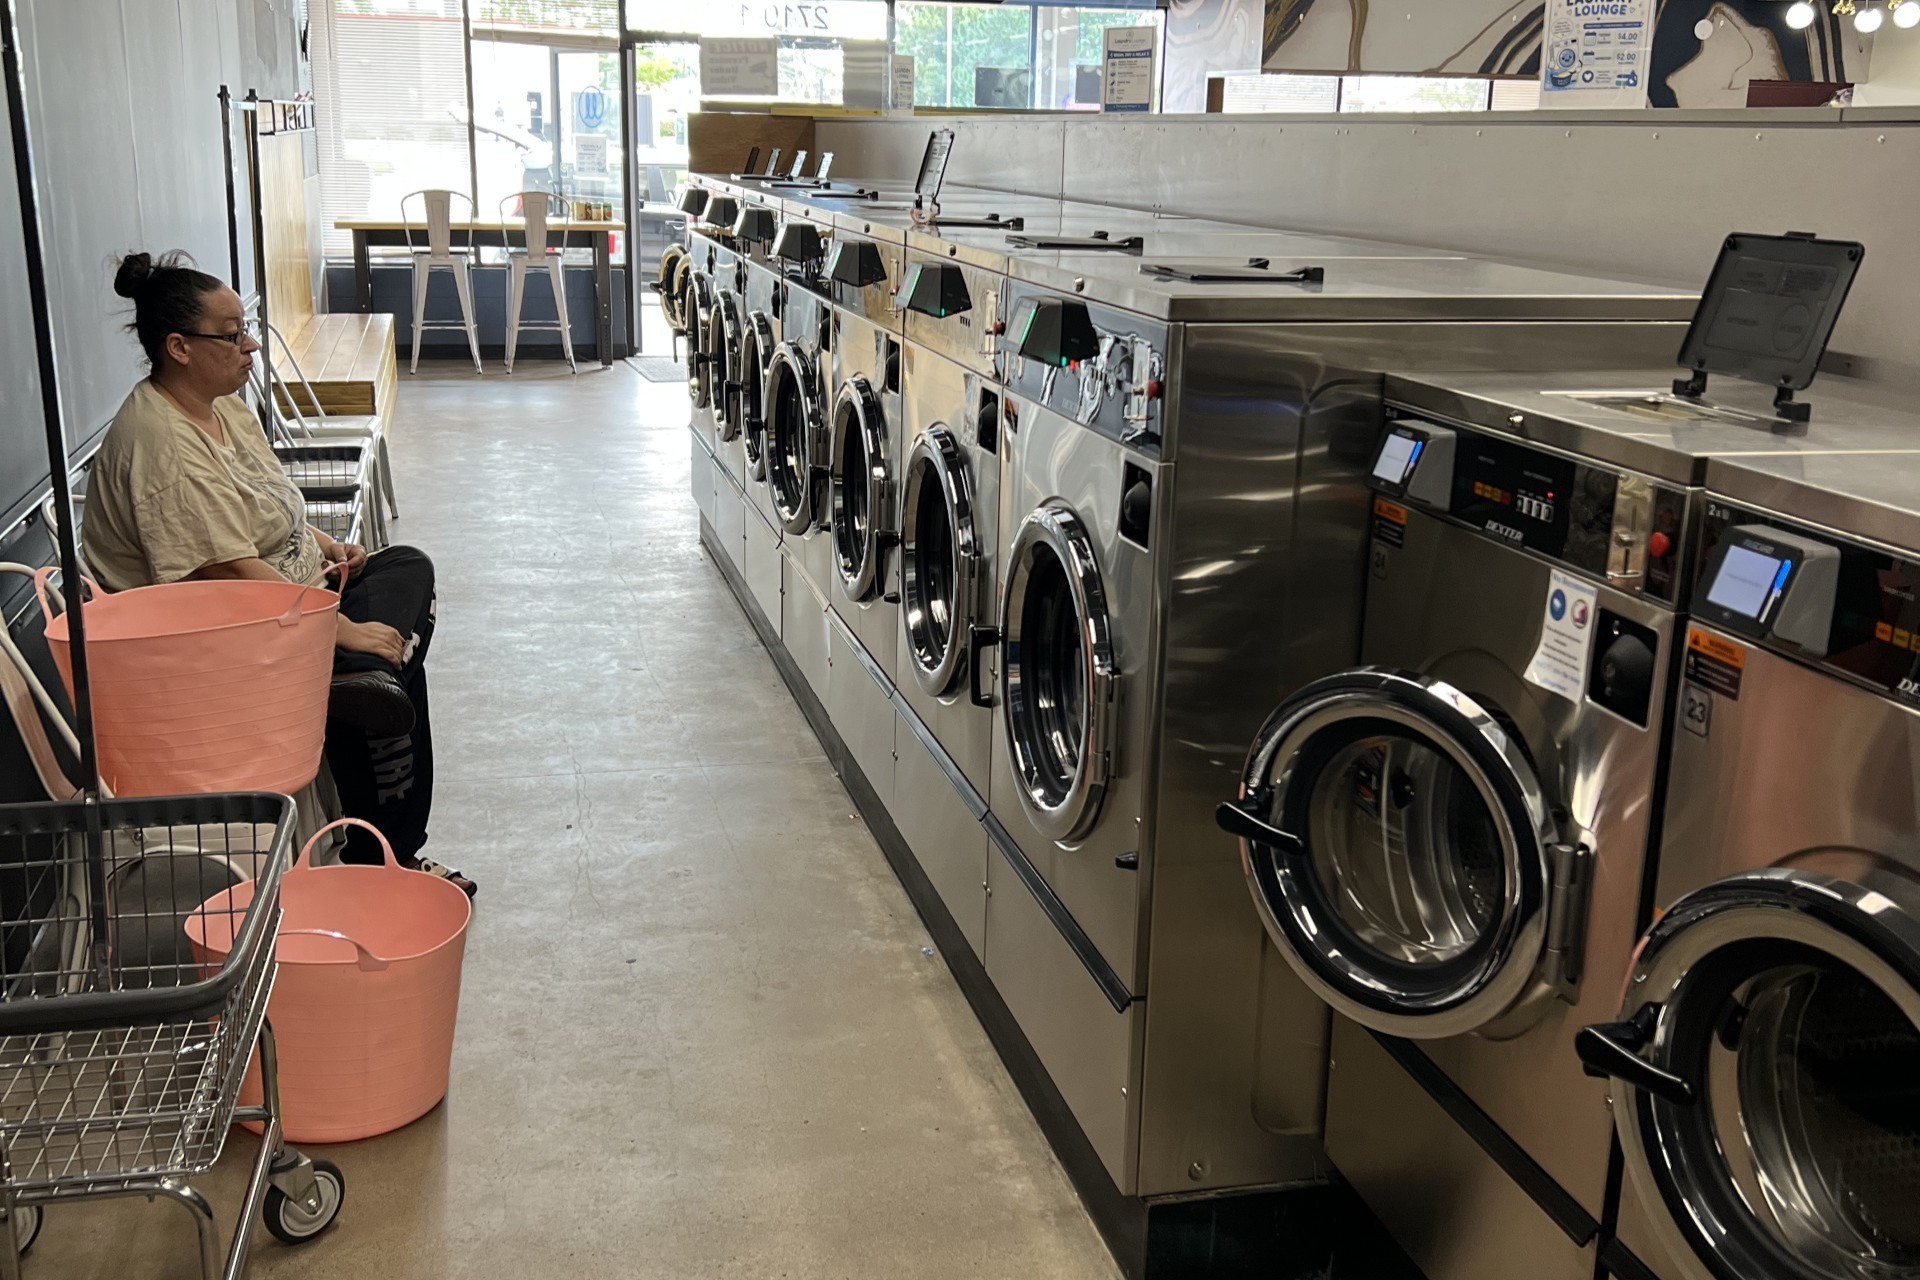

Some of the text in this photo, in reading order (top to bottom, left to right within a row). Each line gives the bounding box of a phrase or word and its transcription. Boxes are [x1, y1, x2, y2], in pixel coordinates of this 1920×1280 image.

[1575, 4, 1627, 16] LOUNGE
[1617, 52, 1636, 60] $2.00
[1485, 519, 1524, 541] DEXTER
[1896, 677, 1920, 697] DE
[1687, 697, 1706, 723] 23
[367, 732, 414, 805] ARE
